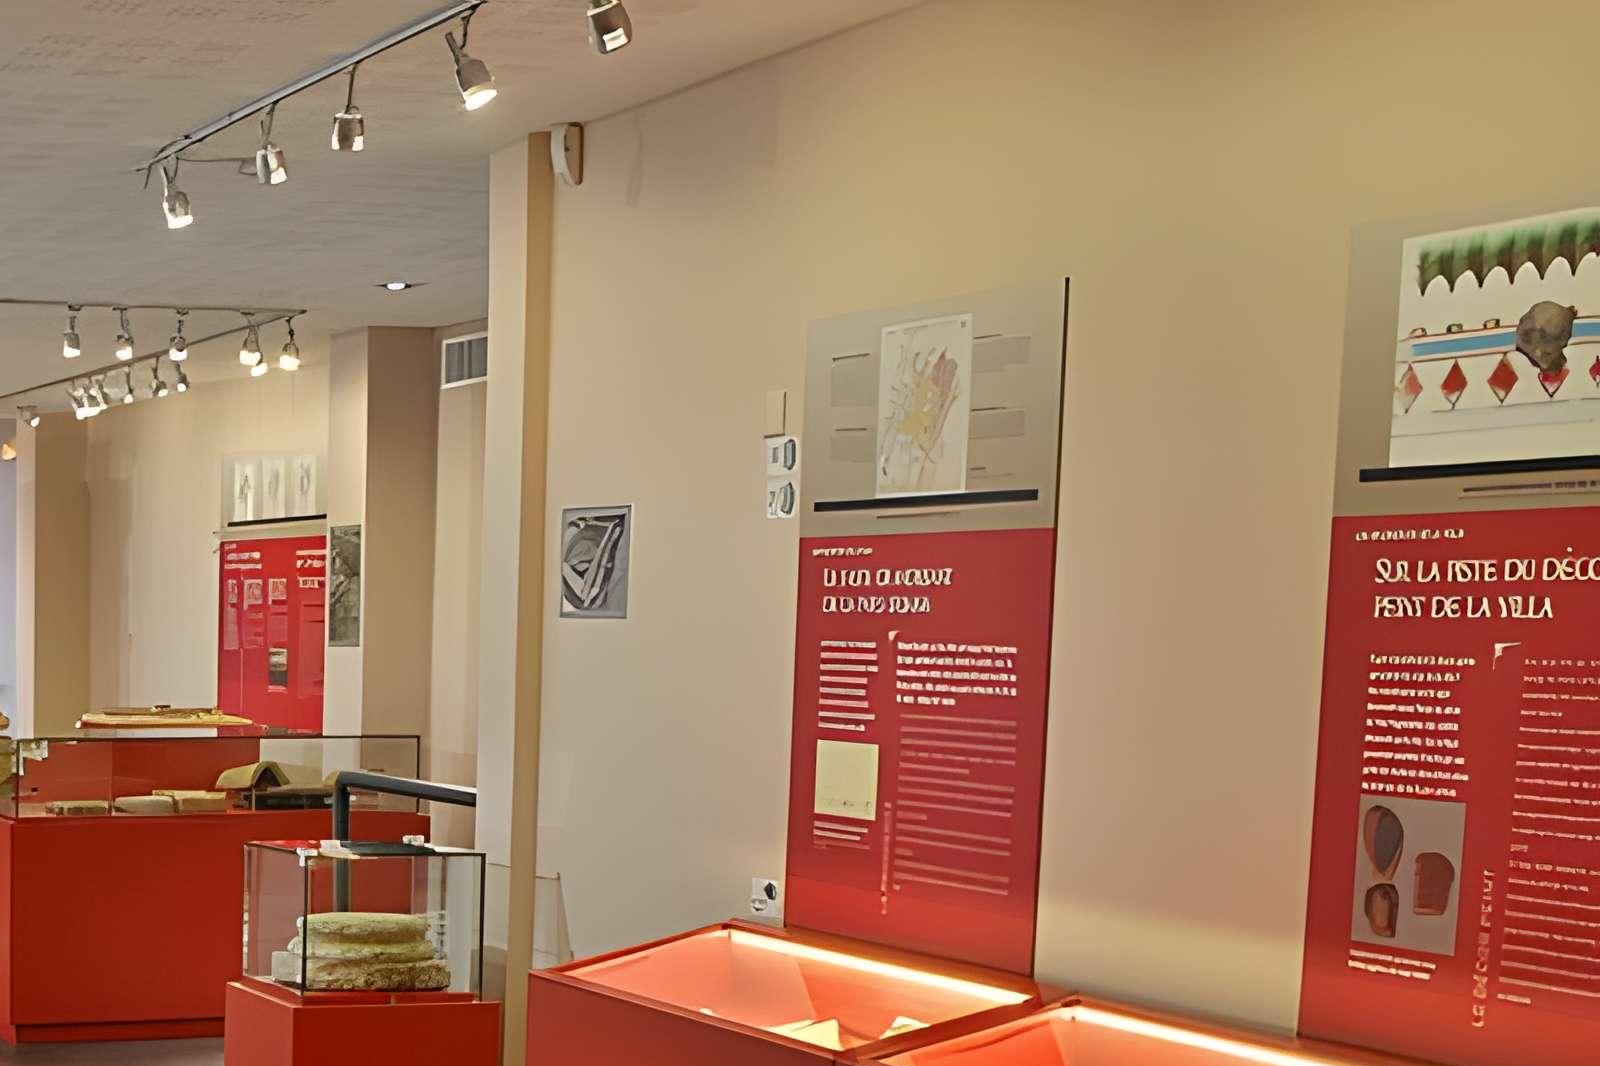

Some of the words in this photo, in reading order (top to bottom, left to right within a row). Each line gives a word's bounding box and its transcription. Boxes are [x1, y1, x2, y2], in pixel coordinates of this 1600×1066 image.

[1417, 560, 1440, 582] LA
[1504, 558, 1536, 581] DU
[1431, 596, 1462, 618] DE
[1467, 596, 1491, 618] LA
